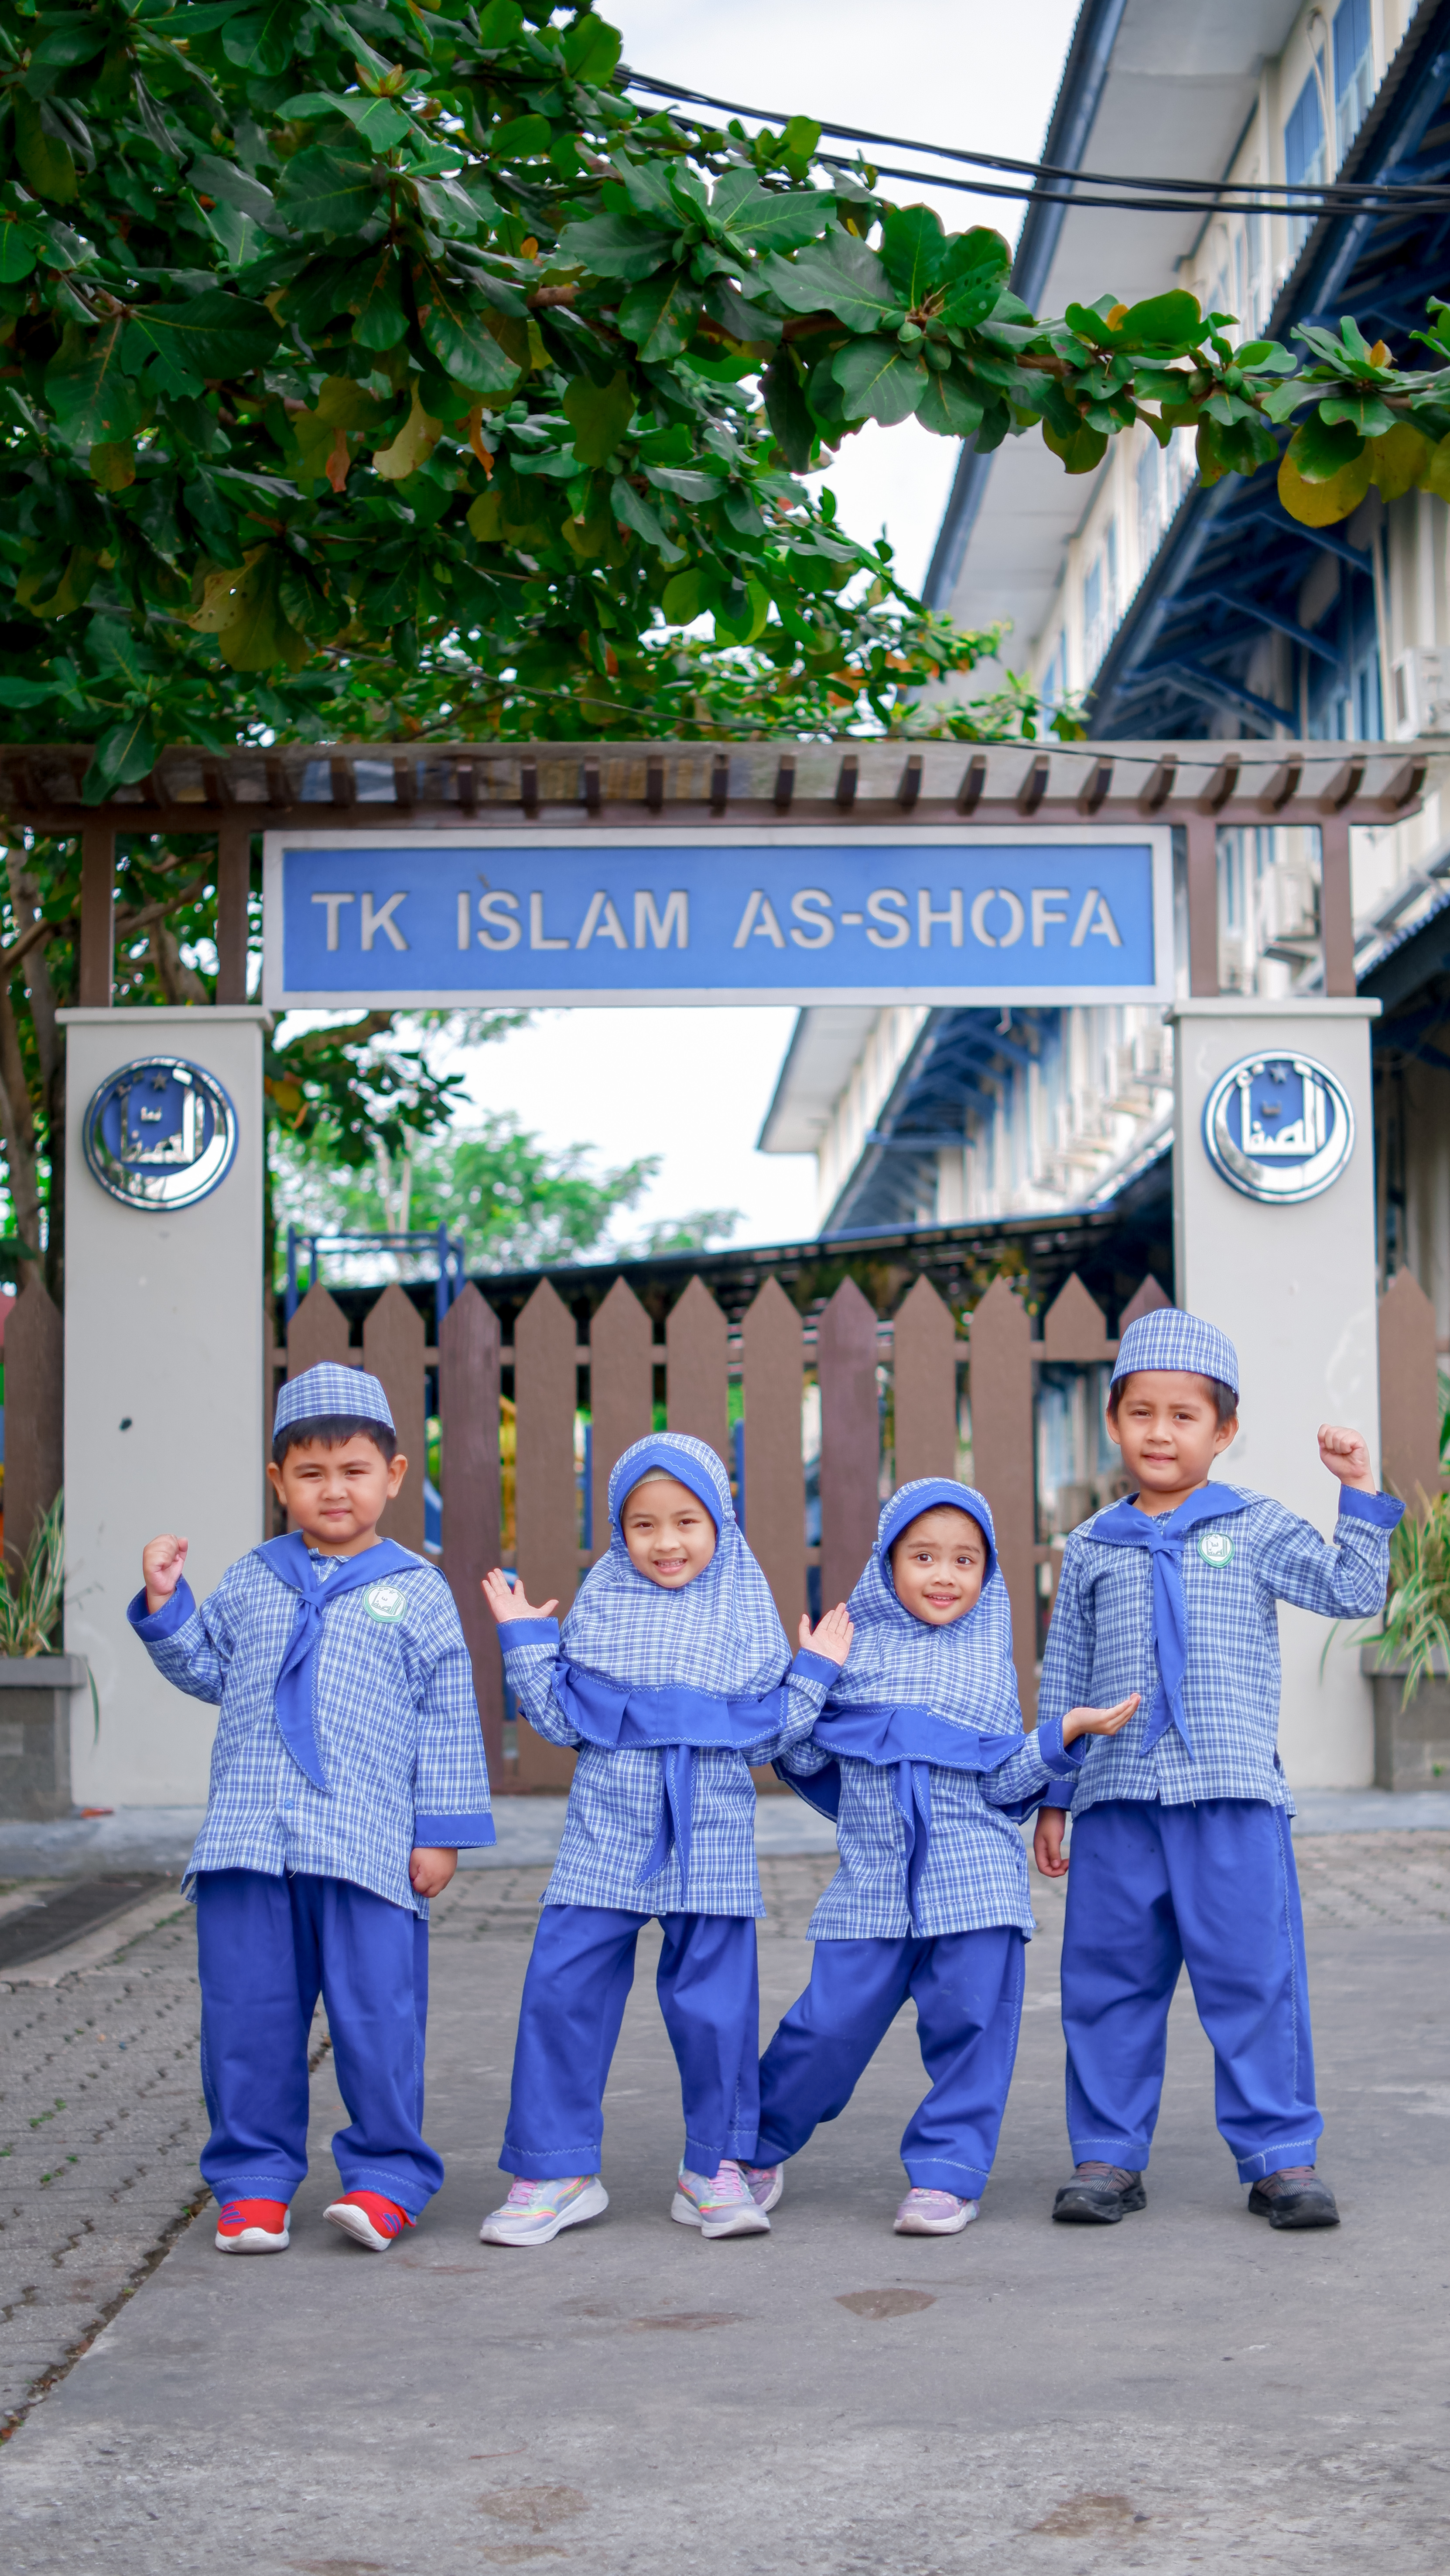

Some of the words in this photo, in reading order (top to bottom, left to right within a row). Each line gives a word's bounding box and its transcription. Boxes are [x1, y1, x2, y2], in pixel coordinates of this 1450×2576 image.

[311, 892, 409, 951] TK
[457, 891, 688, 951] ISLAM
[733, 888, 1122, 948] AS-SHOFA
